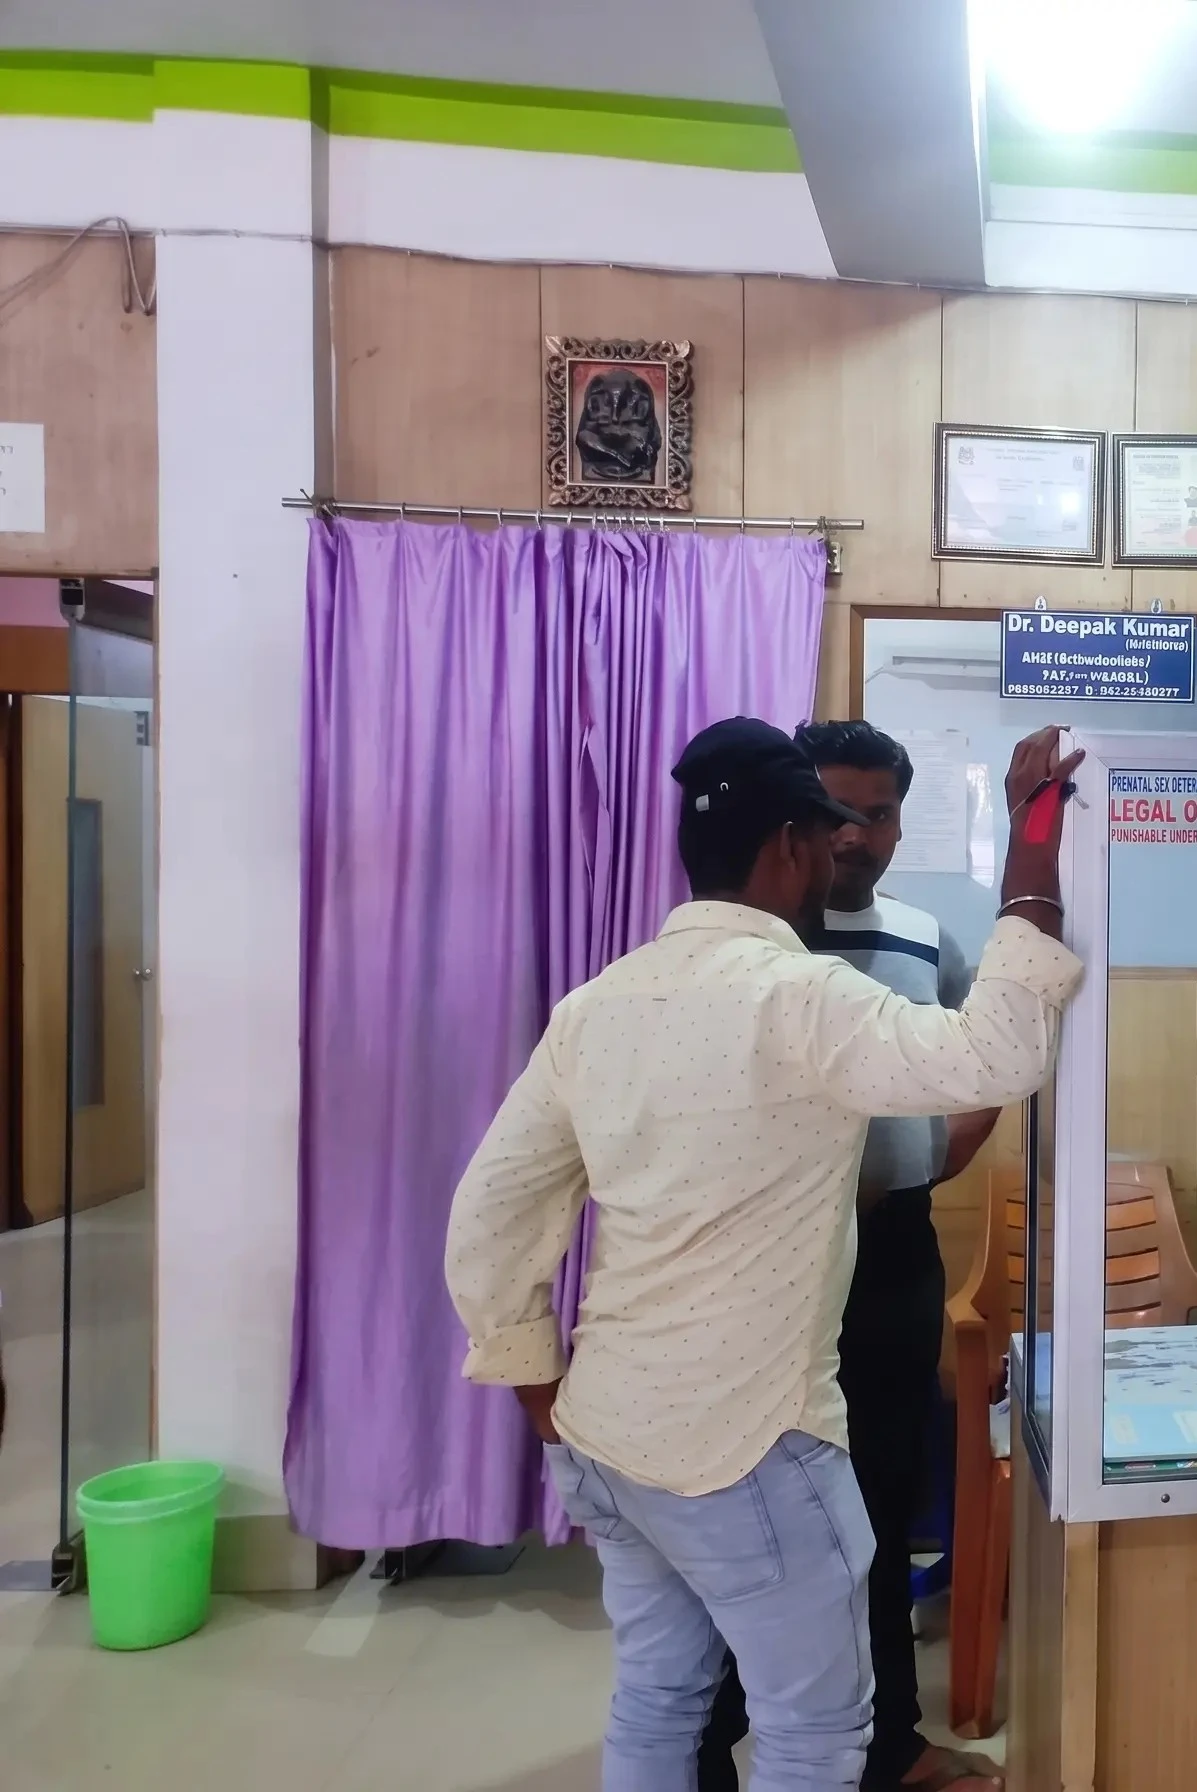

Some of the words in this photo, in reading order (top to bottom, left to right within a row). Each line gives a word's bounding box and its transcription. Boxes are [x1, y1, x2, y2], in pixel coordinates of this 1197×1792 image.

[1008, 614, 1034, 632] Dr.
[1040, 615, 1117, 638] Deepak
[1123, 618, 1189, 637] Kumar
[1112, 776, 1152, 793] PRENATAL
[1154, 777, 1169, 793] SEX
[1111, 799, 1176, 823] LEGAL
[1112, 829, 1167, 843] PUNISHABLE
